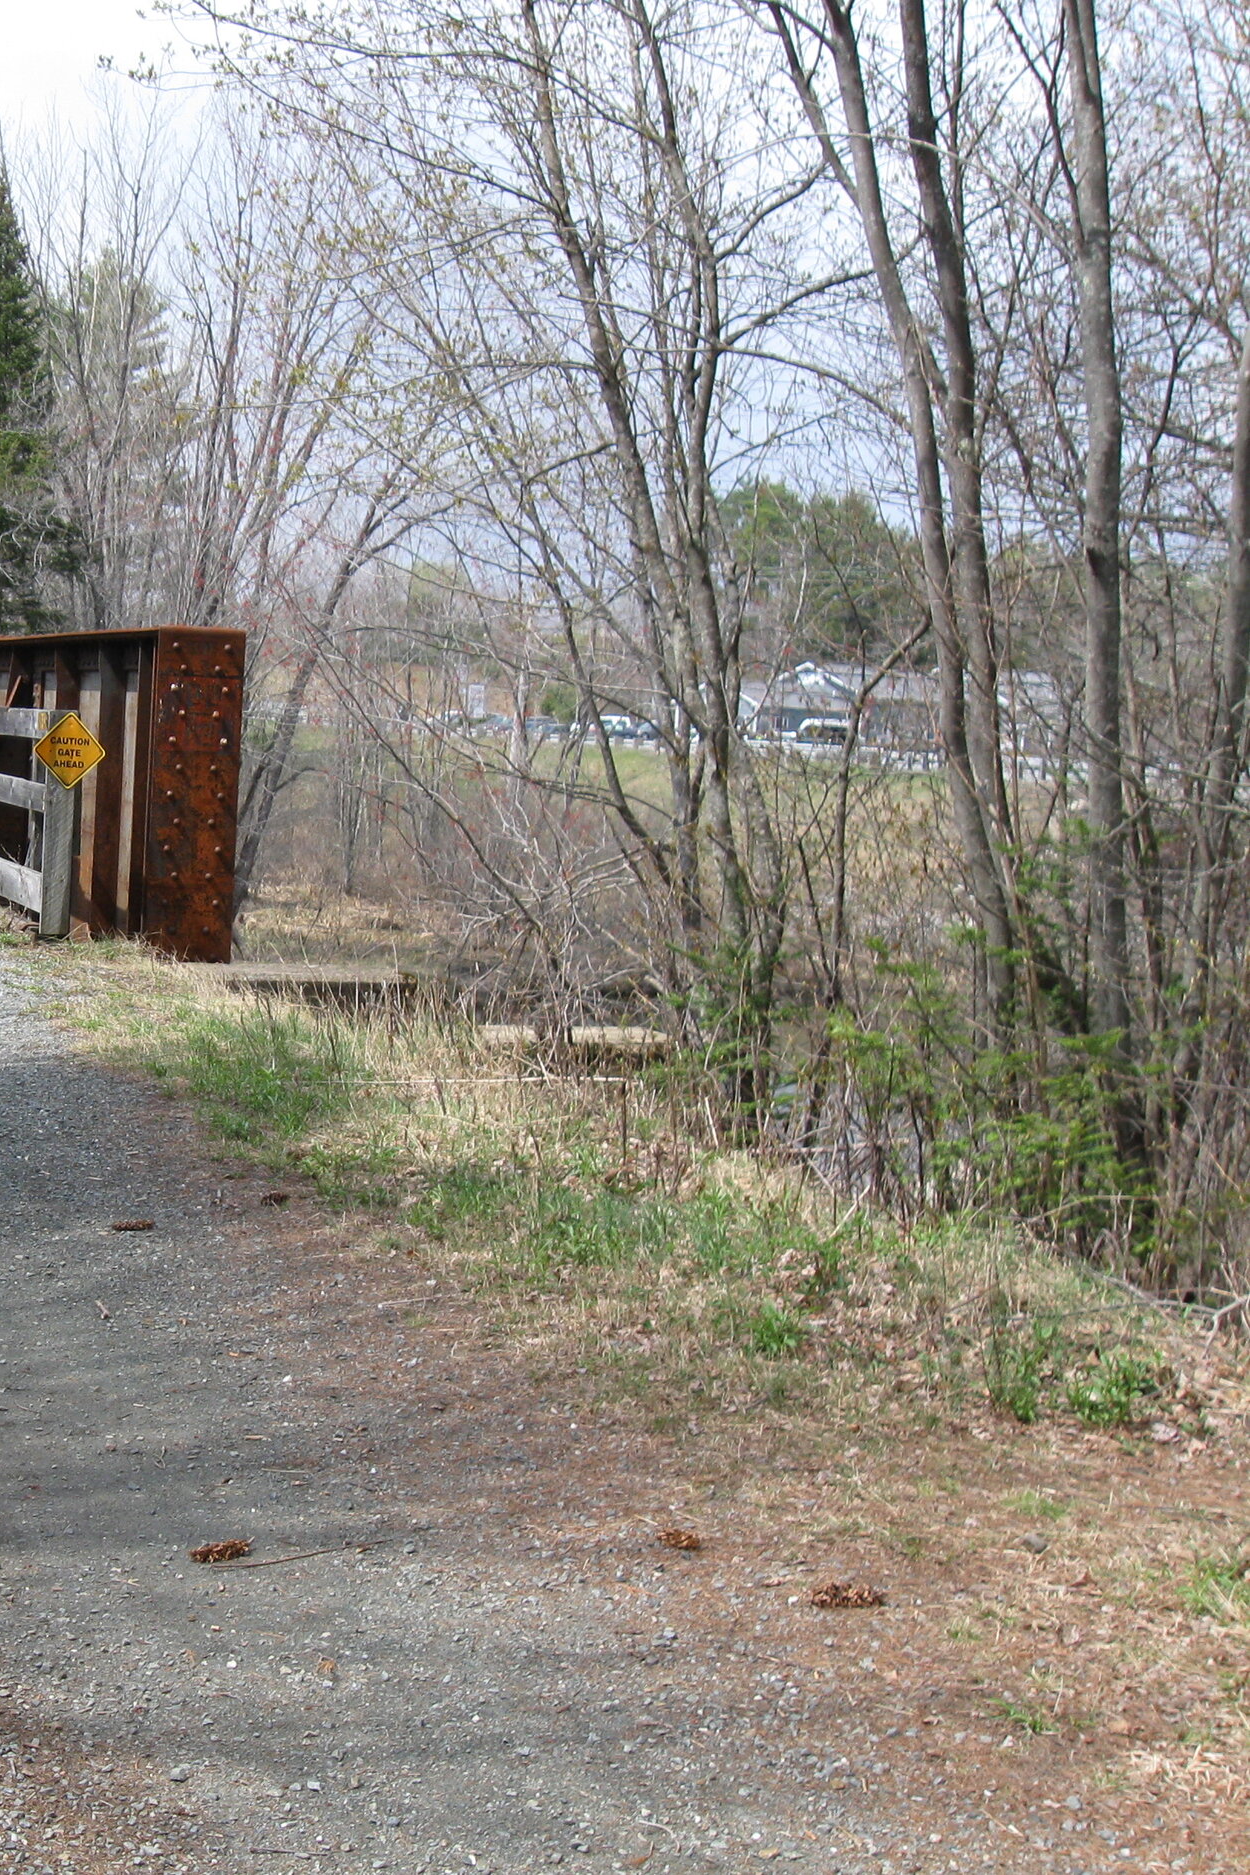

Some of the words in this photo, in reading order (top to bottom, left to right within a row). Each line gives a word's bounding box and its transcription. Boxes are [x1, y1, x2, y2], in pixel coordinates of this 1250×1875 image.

[50, 736, 90, 746] CAUTION
[57, 748, 81, 757] GATE
[53, 759, 84, 768] AHEAD
